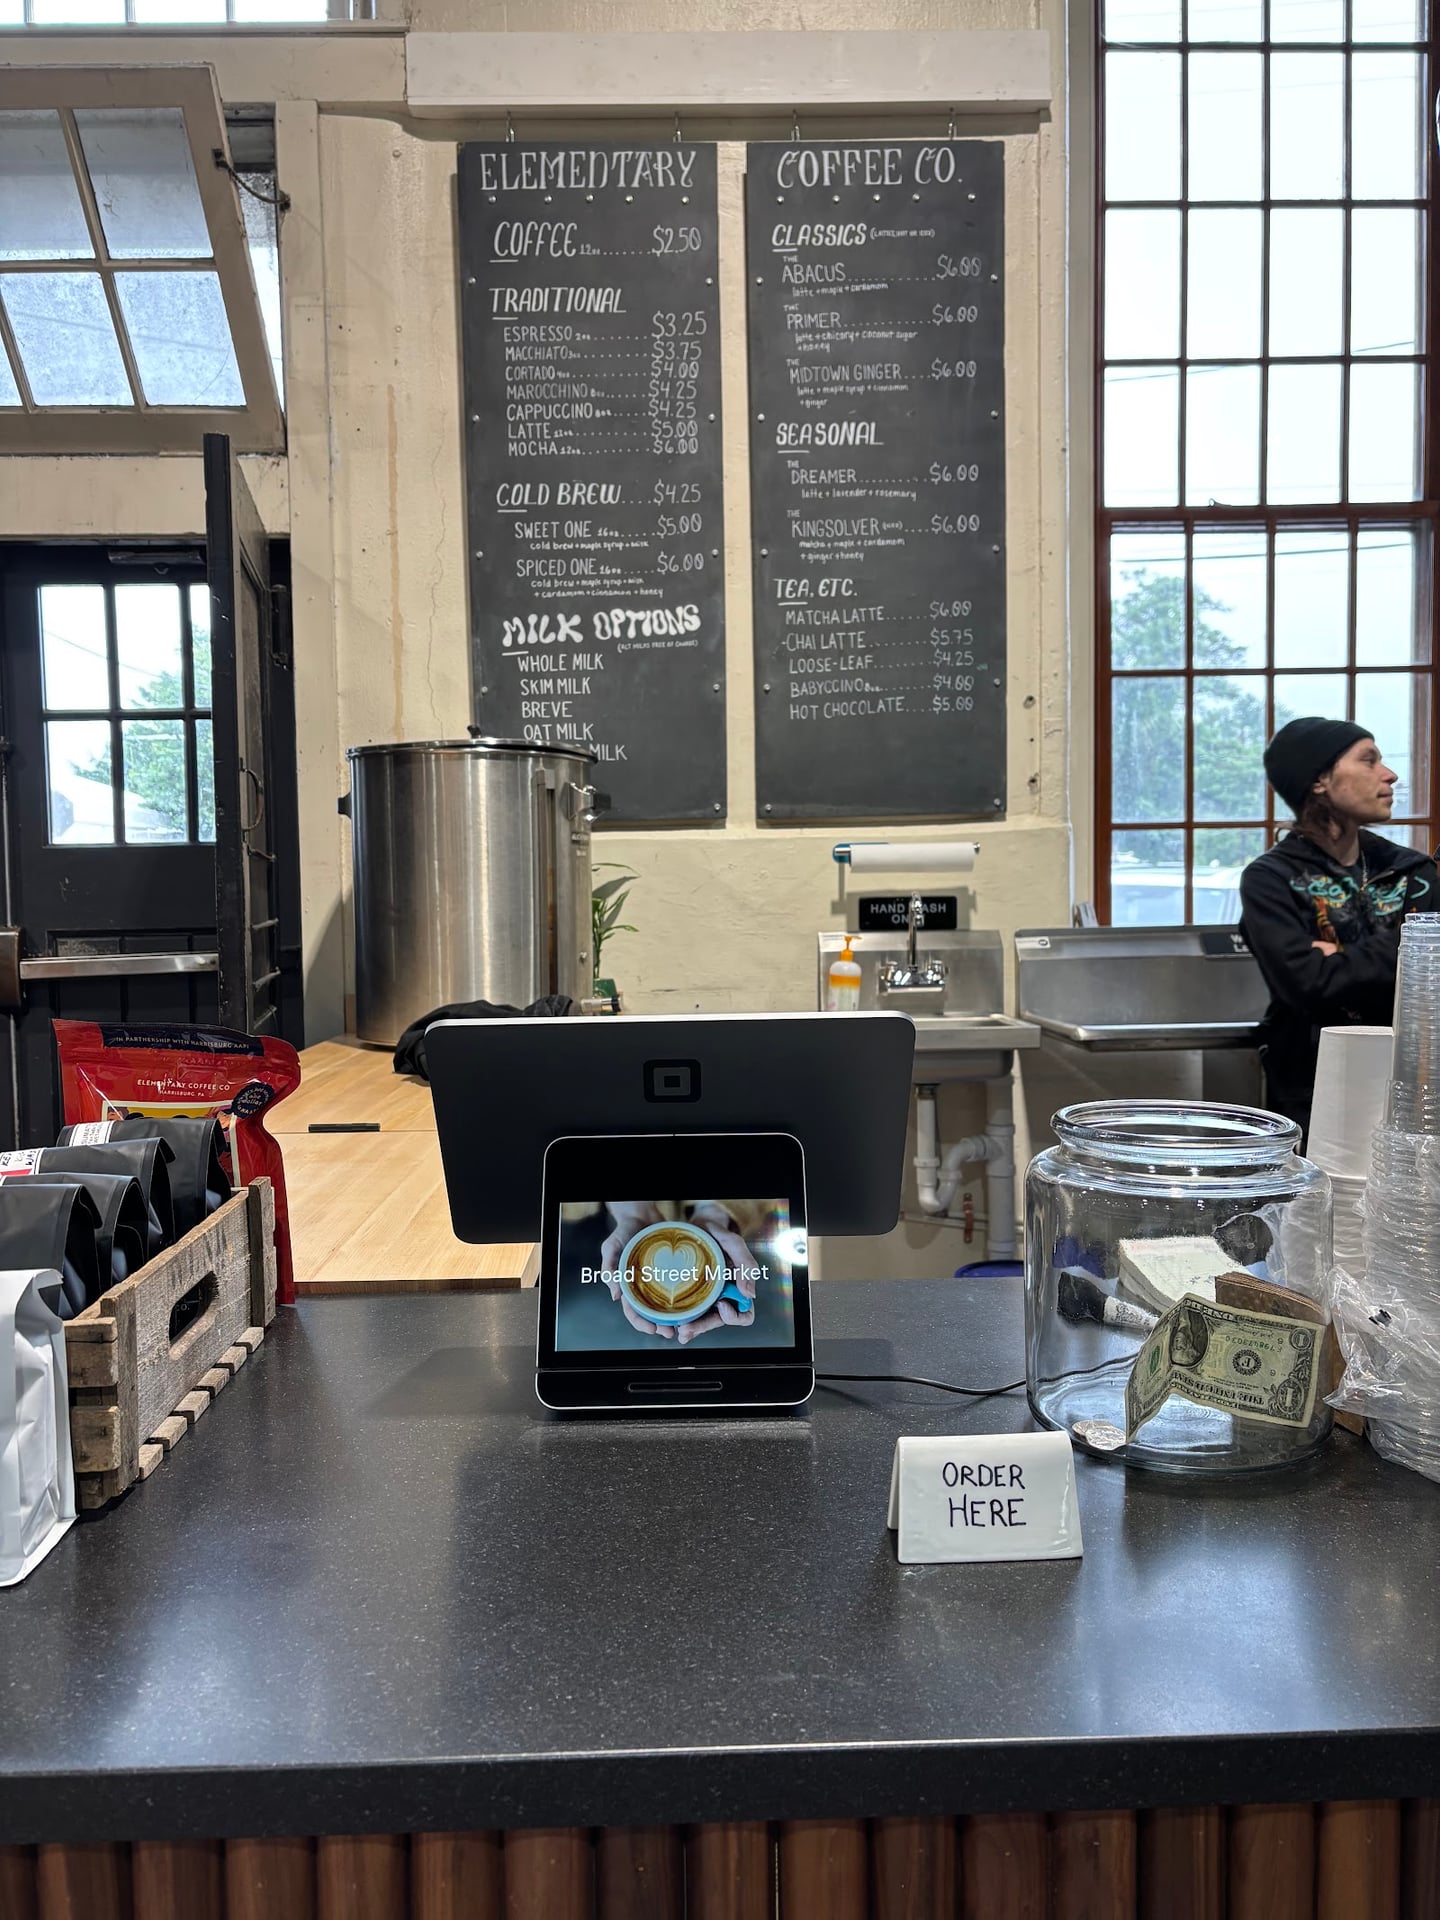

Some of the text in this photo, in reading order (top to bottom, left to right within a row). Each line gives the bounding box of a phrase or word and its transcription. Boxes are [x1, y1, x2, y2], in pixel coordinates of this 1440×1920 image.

[480, 150, 697, 191] ELEMENTARY
[777, 147, 963, 188] COFFEE CO.
[493, 221, 578, 257] COFFEE
[651, 224, 702, 257] $2.50
[771, 222, 867, 247] CLASSICS
[781, 253, 982, 285] ABACUS $6.00
[782, 254, 799, 264] THE
[488, 286, 627, 314] TRADITIONAL
[783, 303, 800, 312] THE
[503, 325, 573, 343] ESPRESSO
[651, 311, 707, 342] $3.25
[786, 302, 978, 330] PRIMER $6.00
[504, 345, 569, 362] MACCHIATO
[651, 340, 702, 363] $3.75
[785, 358, 800, 367] THE
[504, 365, 555, 382] CORTADO
[650, 360, 700, 380] $4.00
[789, 357, 977, 385] MIDTOWN GINGER $6.00
[506, 383, 588, 400] MAROCCHINO
[649, 379, 697, 400] $4.25
[506, 402, 593, 421] CAPPUCCINO
[648, 399, 697, 419] $4.25
[507, 422, 552, 440] LATTE
[651, 418, 699, 439] $5.00
[775, 421, 885, 446] SEASONAL
[508, 441, 558, 457] MOCHA
[652, 438, 699, 455] $6.00
[787, 459, 800, 469] THE
[790, 461, 980, 486] DREAMER $6.00
[496, 478, 702, 507] COLD BREW $4.25
[786, 509, 801, 518] THE
[791, 517, 881, 538] KINGSOLVER
[930, 513, 980, 535] $6.00
[514, 521, 560, 539] SWEET
[564, 519, 593, 539] ONE
[656, 512, 703, 540] $5.00
[530, 541, 552, 551] cold
[552, 541, 574, 550] brew
[516, 558, 567, 578] SPICED
[569, 557, 598, 577] ONE
[656, 550, 705, 575] $6.00
[530, 578, 552, 589] cold
[553, 578, 575, 588] brew
[817, 577, 859, 598] ETC.
[501, 603, 702, 648] MILK OPTIONS
[785, 600, 973, 627] MATCHA LATTE $6.00
[785, 627, 975, 652] CHAI LATTE $5.75
[517, 652, 605, 673] WHOLE MILK
[789, 648, 975, 675] LOOSE-LEAF $4.25
[519, 676, 592, 696] SKIM MILK
[790, 678, 864, 698] BABYCCINO
[932, 672, 975, 692] $4.00
[521, 700, 574, 719] BREVE
[789, 695, 974, 721] HOT CHOCOLATE $5.00
[523, 722, 595, 742] OAT MILK
[589, 743, 629, 762] MILK
[870, 903, 906, 914] HAND
[125, 1036, 171, 1044] PARTNERSHIP
[190, 1039, 233, 1049] HARRISBURG
[188, 1082, 218, 1091] COFFEE
[218, 1083, 231, 1091] CO
[580, 1262, 770, 1285] Broad Street Market
[942, 1461, 1026, 1490] ORDER
[948, 1493, 1027, 1528] HERE
